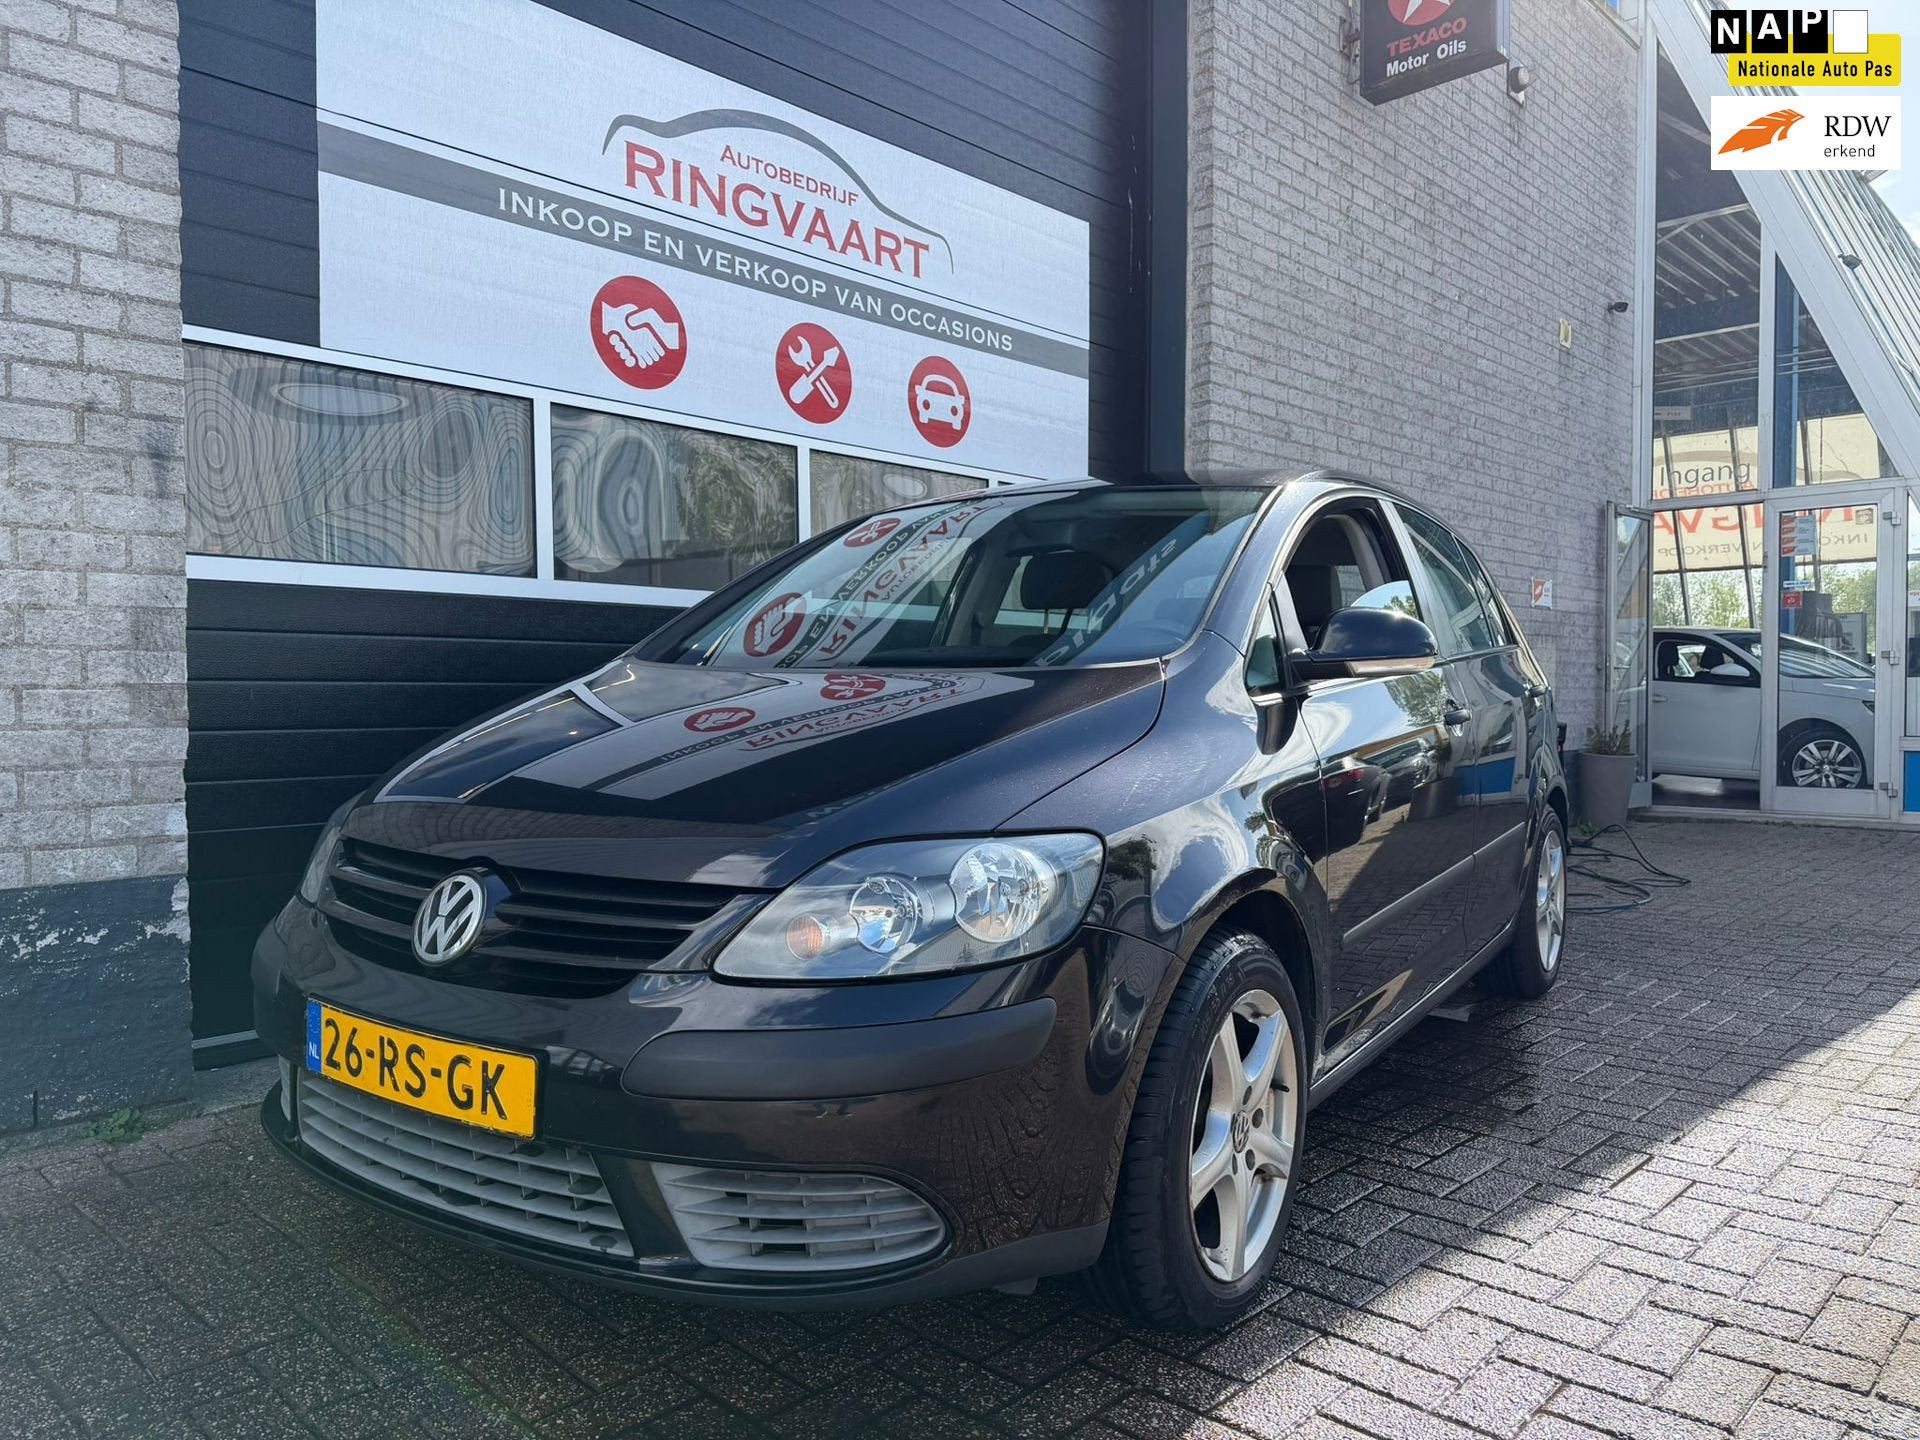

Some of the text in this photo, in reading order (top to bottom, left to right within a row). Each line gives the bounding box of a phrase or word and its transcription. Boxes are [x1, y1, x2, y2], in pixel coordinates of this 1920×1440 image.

[1386, 17, 1468, 57] TEXACO
[1386, 39, 1467, 77] Motor Oils
[719, 144, 859, 207] AUTOBEDRIJF
[623, 140, 930, 279] RINGVAART
[498, 187, 1014, 352] INKOOP EN VERKOOP VAN OCCASIONS
[1660, 462, 1751, 489] Ingang
[308, 1041, 320, 1060] NL
[324, 1018, 508, 1121] 26-RS-GK
